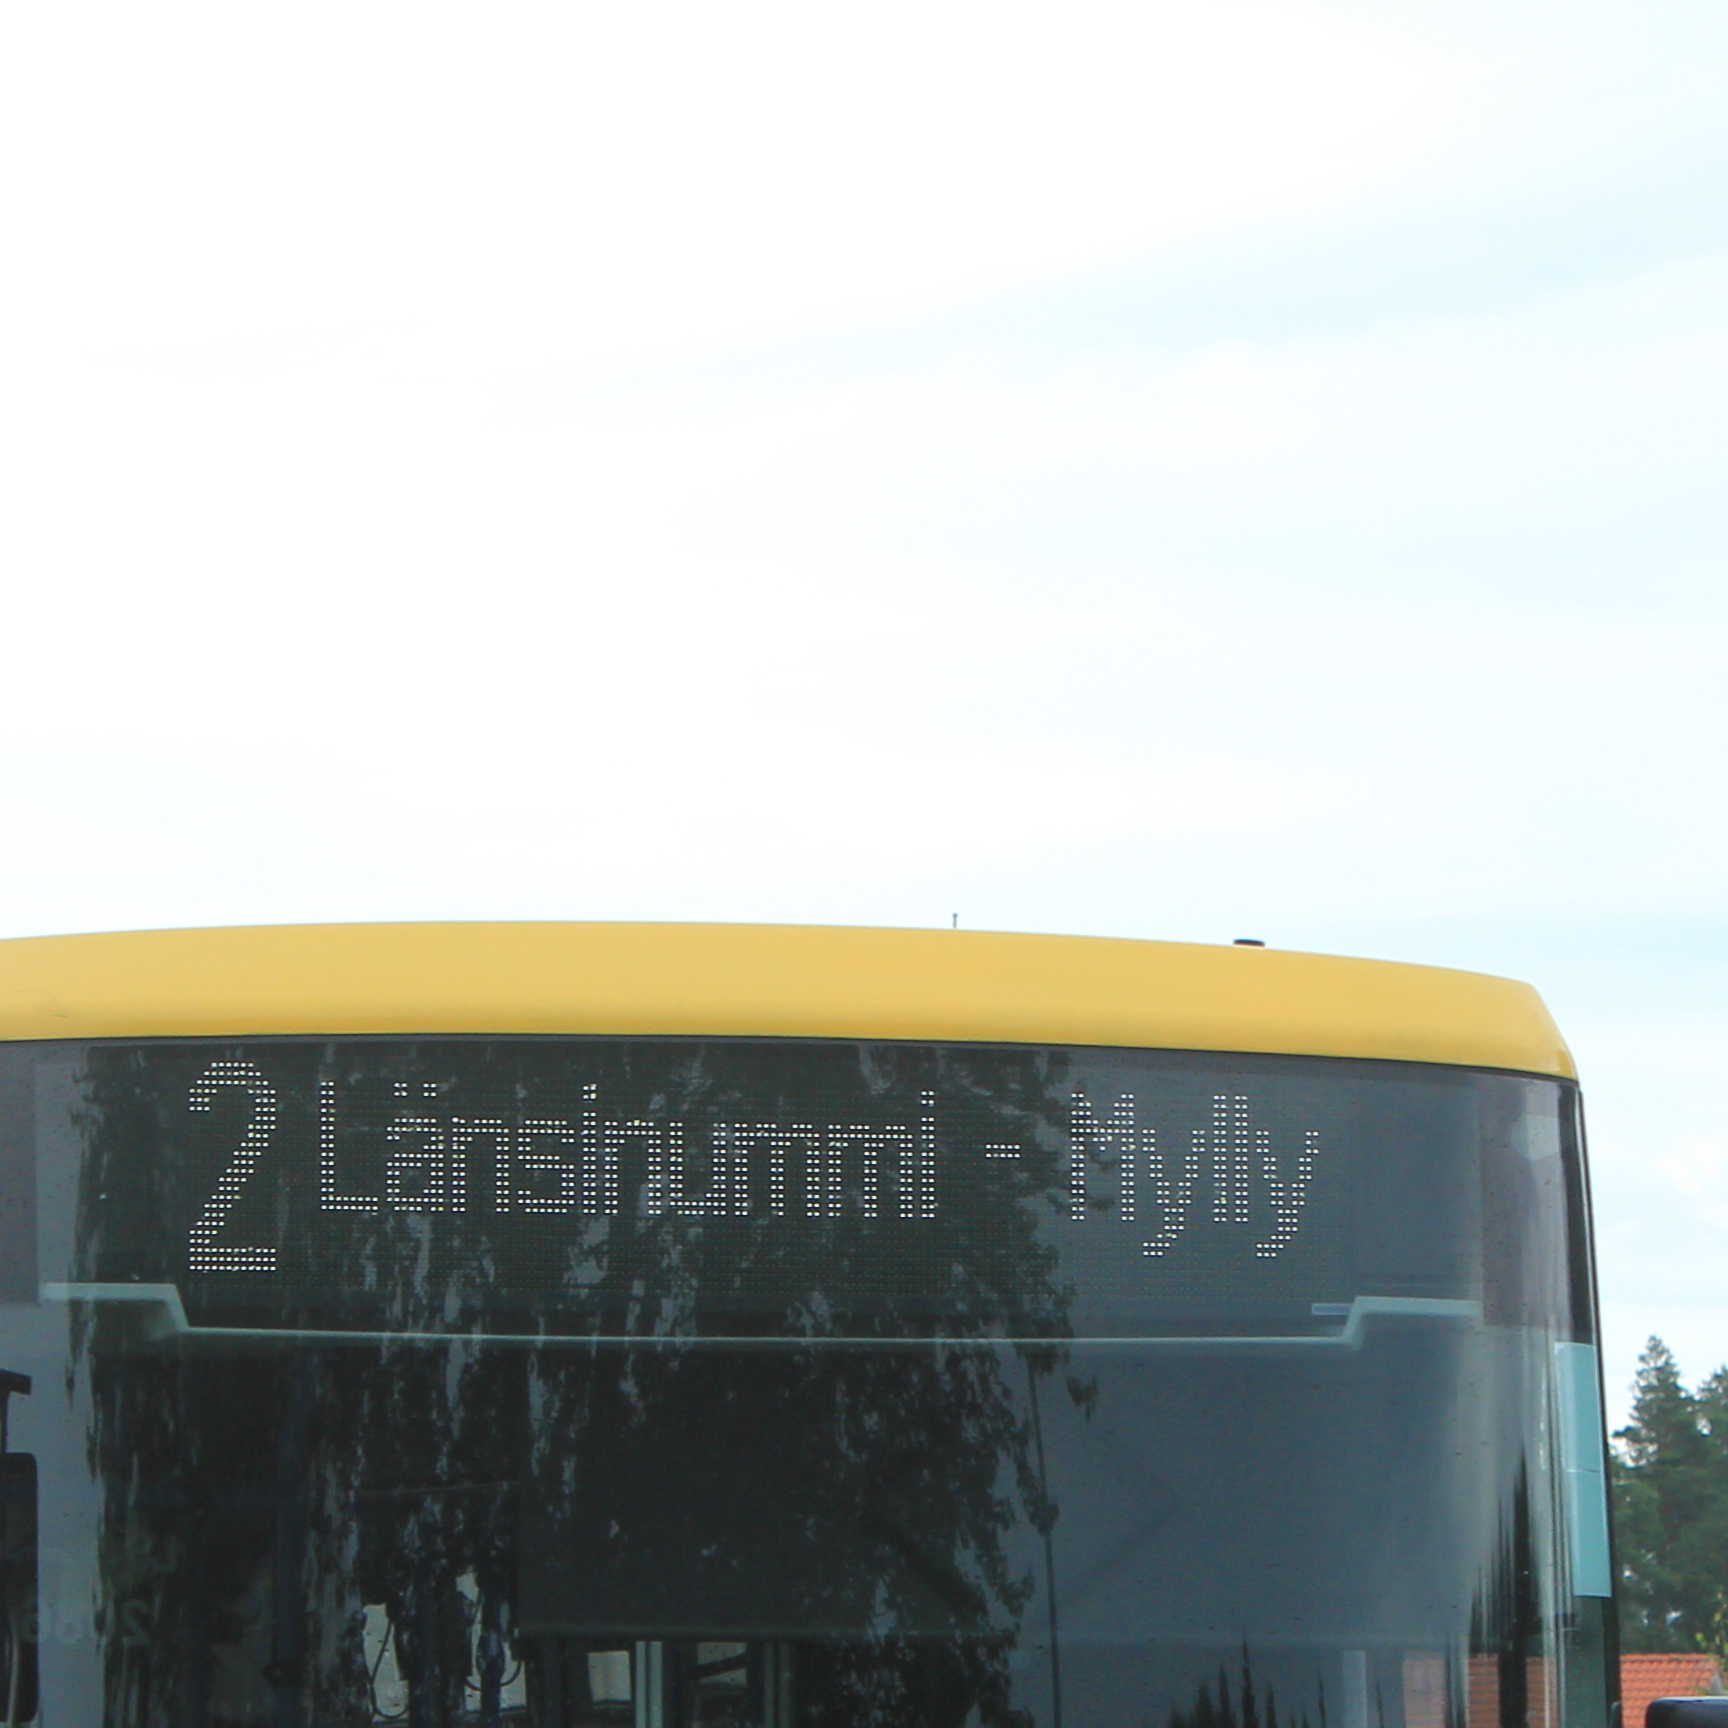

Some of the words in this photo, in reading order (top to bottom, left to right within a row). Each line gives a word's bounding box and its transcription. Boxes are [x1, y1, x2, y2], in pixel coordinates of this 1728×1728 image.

[189, 1062, 276, 1271] 2
[321, 1082, 935, 1218] Länsinummi
[985, 1143, 1021, 1159] -
[1071, 1092, 1319, 1257] Mylly
